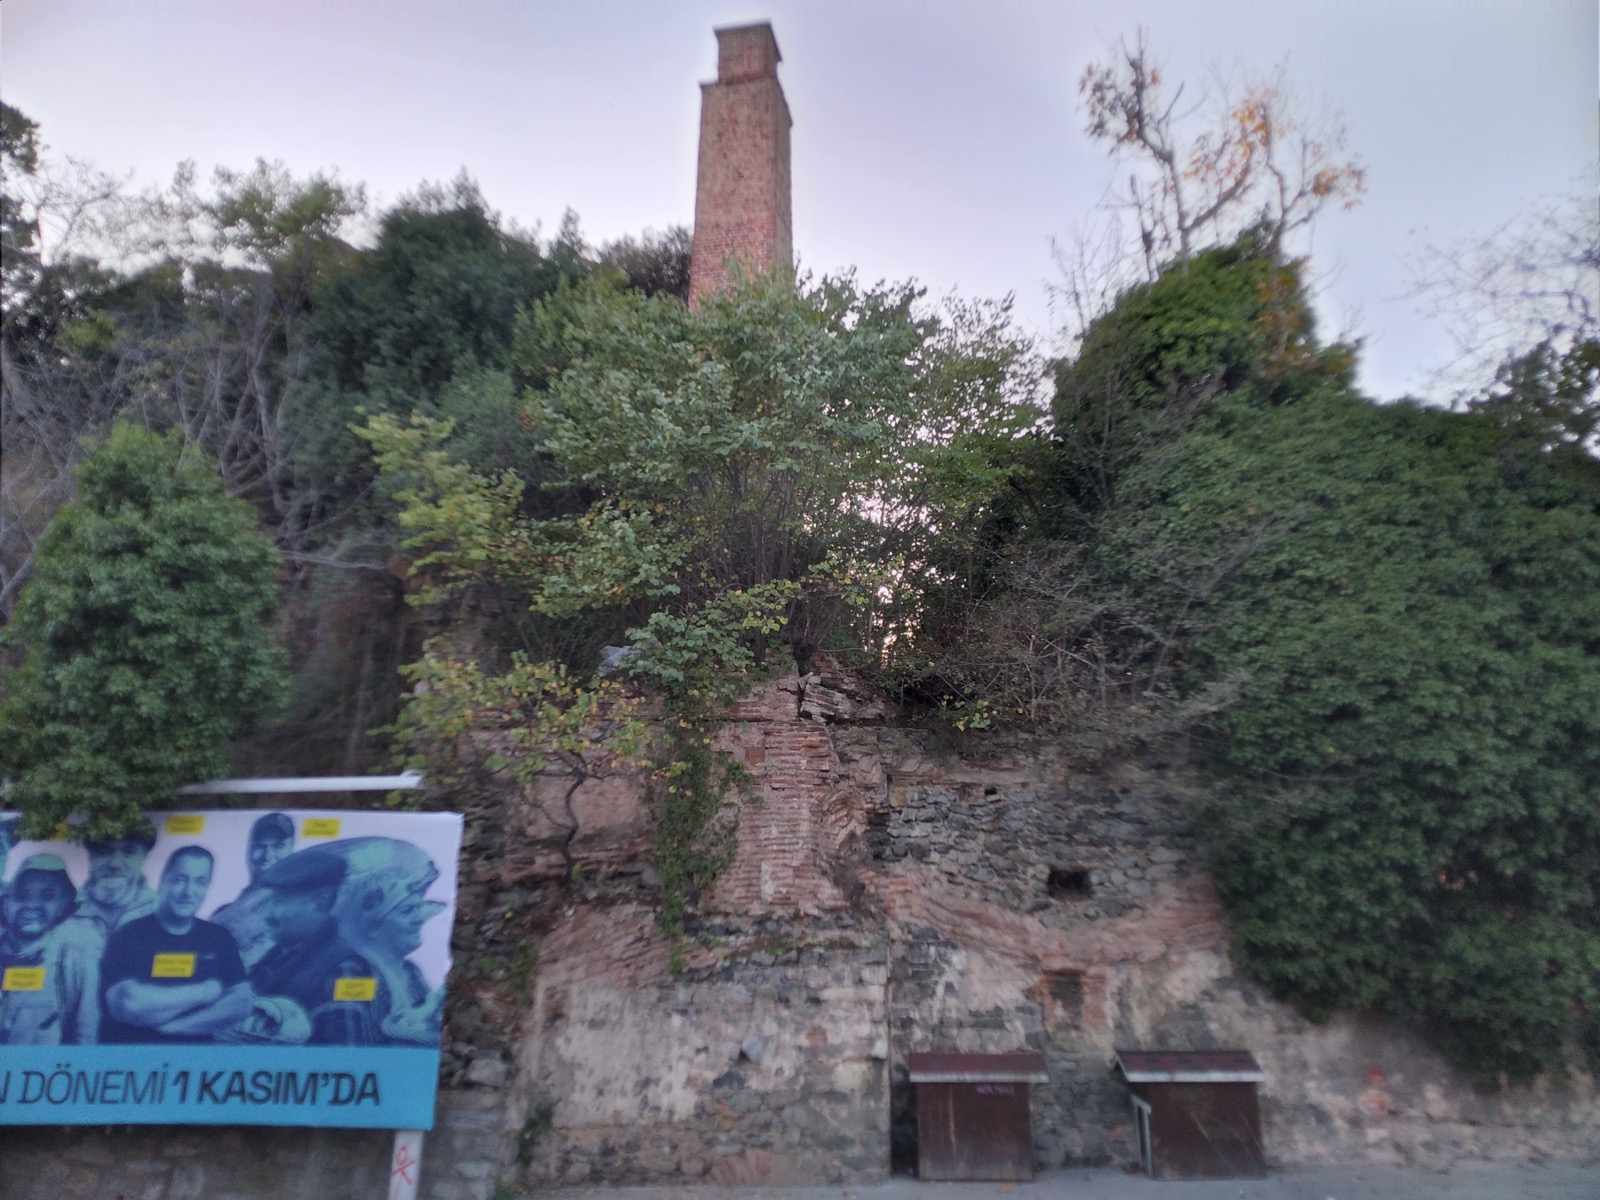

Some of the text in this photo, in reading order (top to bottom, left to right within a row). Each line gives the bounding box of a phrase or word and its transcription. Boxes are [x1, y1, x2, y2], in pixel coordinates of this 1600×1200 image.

[17, 1063, 169, 1105] DÖNEMİ
[172, 1070, 190, 1104] 1
[196, 1070, 380, 1106] KASIM'DA
